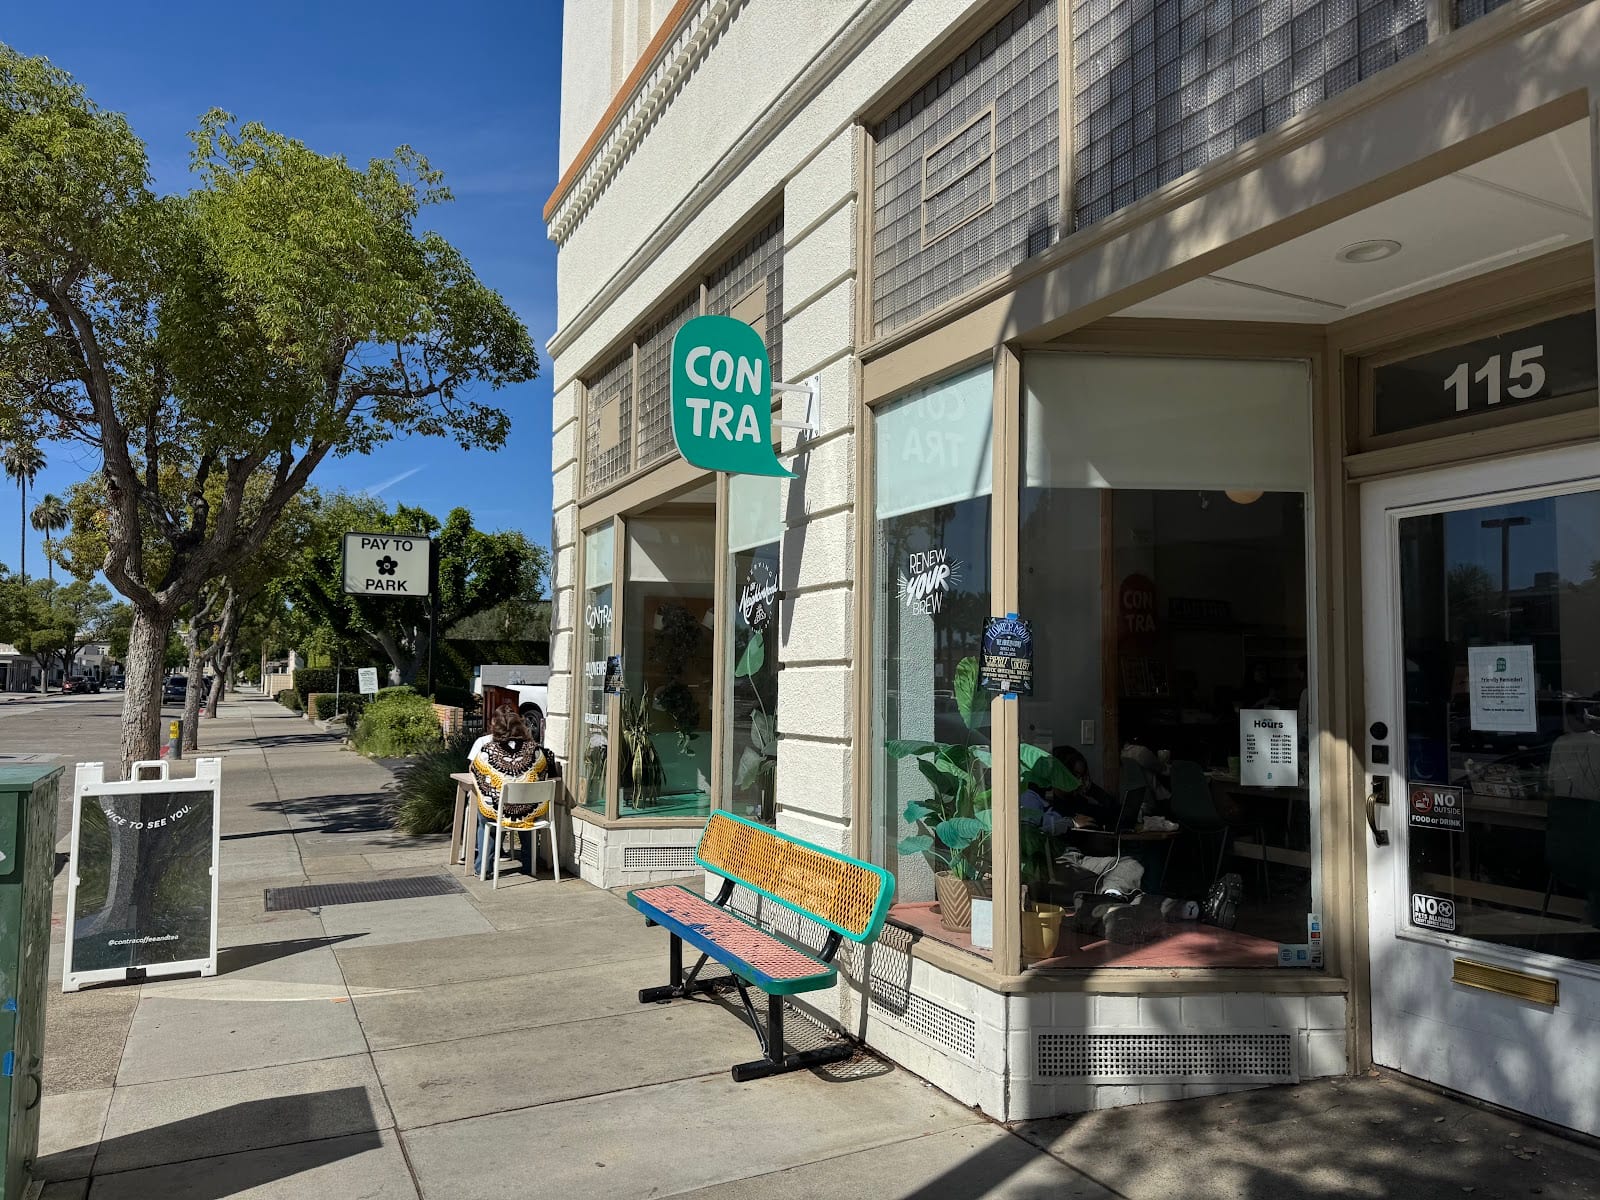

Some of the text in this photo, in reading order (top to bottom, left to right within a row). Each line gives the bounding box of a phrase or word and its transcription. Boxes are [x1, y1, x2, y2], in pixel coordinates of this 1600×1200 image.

[685, 345, 762, 396] CON
[1444, 344, 1546, 412] 115
[685, 397, 762, 443] TRA
[361, 537, 413, 552] PAY TO
[909, 547, 947, 574] RENEW
[365, 578, 408, 592] PARK
[906, 564, 950, 607] YOUR
[912, 591, 943, 616] BREW
[585, 604, 613, 629] CONTRA
[1253, 720, 1284, 729] Hours
[1434, 793, 1455, 807] NO
[103, 804, 192, 830] NICE TO SEE YOU.
[1434, 806, 1462, 814] OUTSIDE
[1411, 814, 1431, 823] FOOD
[1440, 818, 1461, 827] DRINK
[1415, 896, 1438, 914] NO
[1415, 912, 1453, 925] PETS ALLOWED
[108, 934, 179, 946] @contracoffeeandtea
